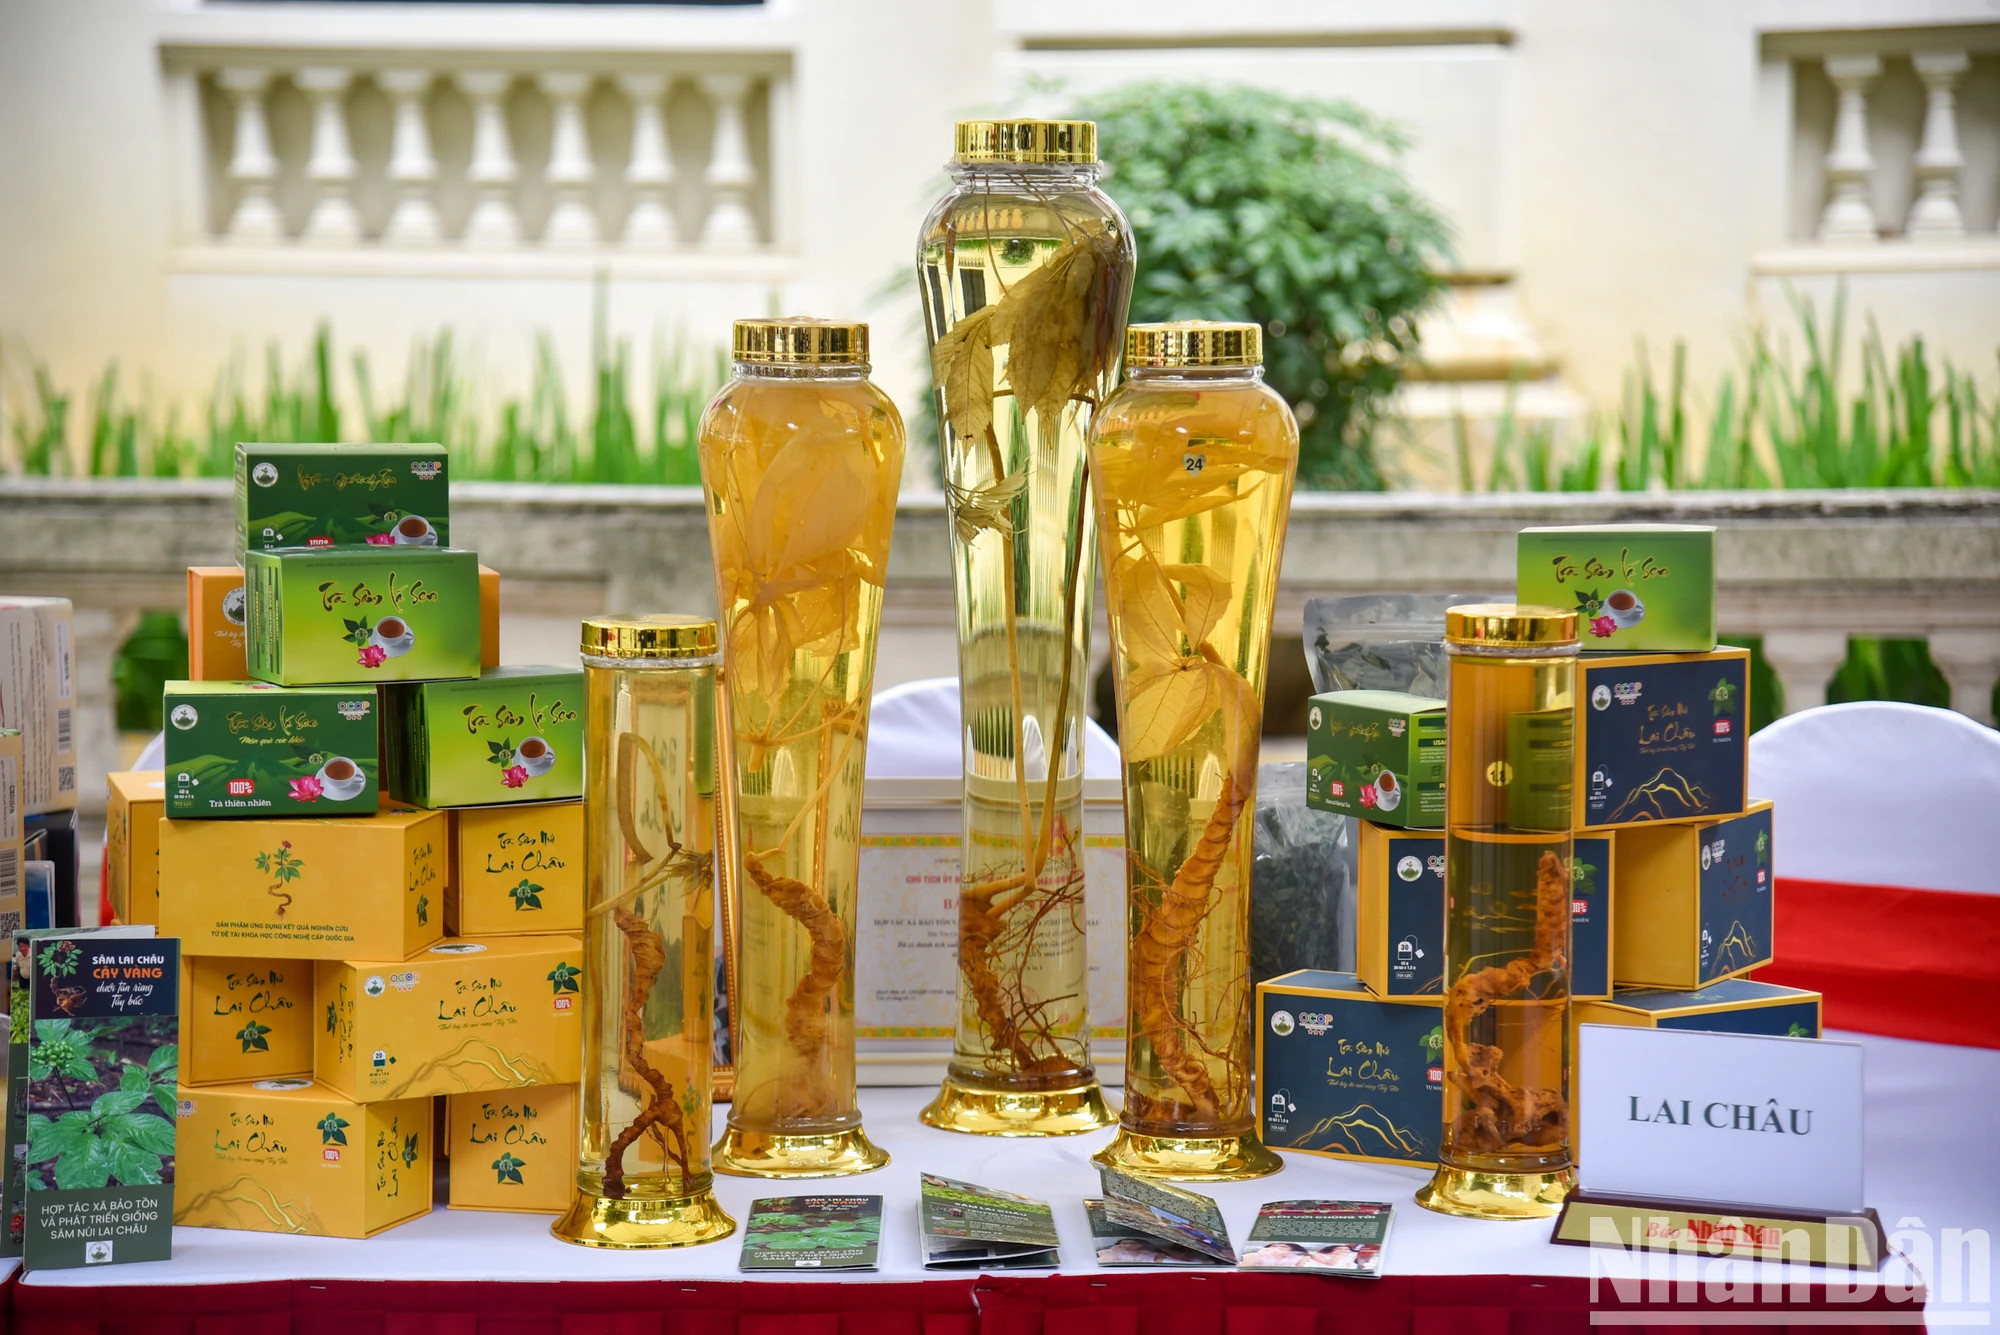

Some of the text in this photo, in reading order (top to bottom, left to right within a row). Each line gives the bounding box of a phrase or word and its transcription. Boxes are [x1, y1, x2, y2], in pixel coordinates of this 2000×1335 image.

[411, 461, 442, 471] OCOP
[1186, 458, 1203, 471] 24
[338, 701, 370, 710] OCOP
[1638, 725, 1660, 744] Lai
[230, 782, 252, 794] 100%
[209, 798, 272, 808] Trà thiên nhiên
[486, 850, 567, 873] Lai Châu
[1572, 902, 1586, 913] 00%
[92, 954, 165, 965] SÂM LAI CHÂU
[93, 965, 163, 979] CÂY VÀNG
[390, 972, 420, 982] OCOP
[214, 990, 293, 1015] Lai Châu
[438, 995, 517, 1020] Lai Châu
[555, 999, 570, 1009] 100%
[1299, 1012, 1333, 1024] OCOP
[1327, 1056, 1400, 1081] Lai Châu
[177, 1100, 198, 1108] COP
[1628, 1096, 1814, 1136] LAI CHÂU
[470, 1123, 548, 1145] Lai Châu
[214, 1130, 288, 1153] Lai Châu
[324, 1150, 339, 1160] 100%
[42, 1197, 158, 1216] HỢP TÁC XÃ BẢO TỒN
[41, 1209, 158, 1227] VÀ PHÁT TRIỂN GIỐNG
[50, 1223, 148, 1240] SÂM NÚI LAI CHÂU
[1646, 1219, 1780, 1245] Báo Nhân Dân
